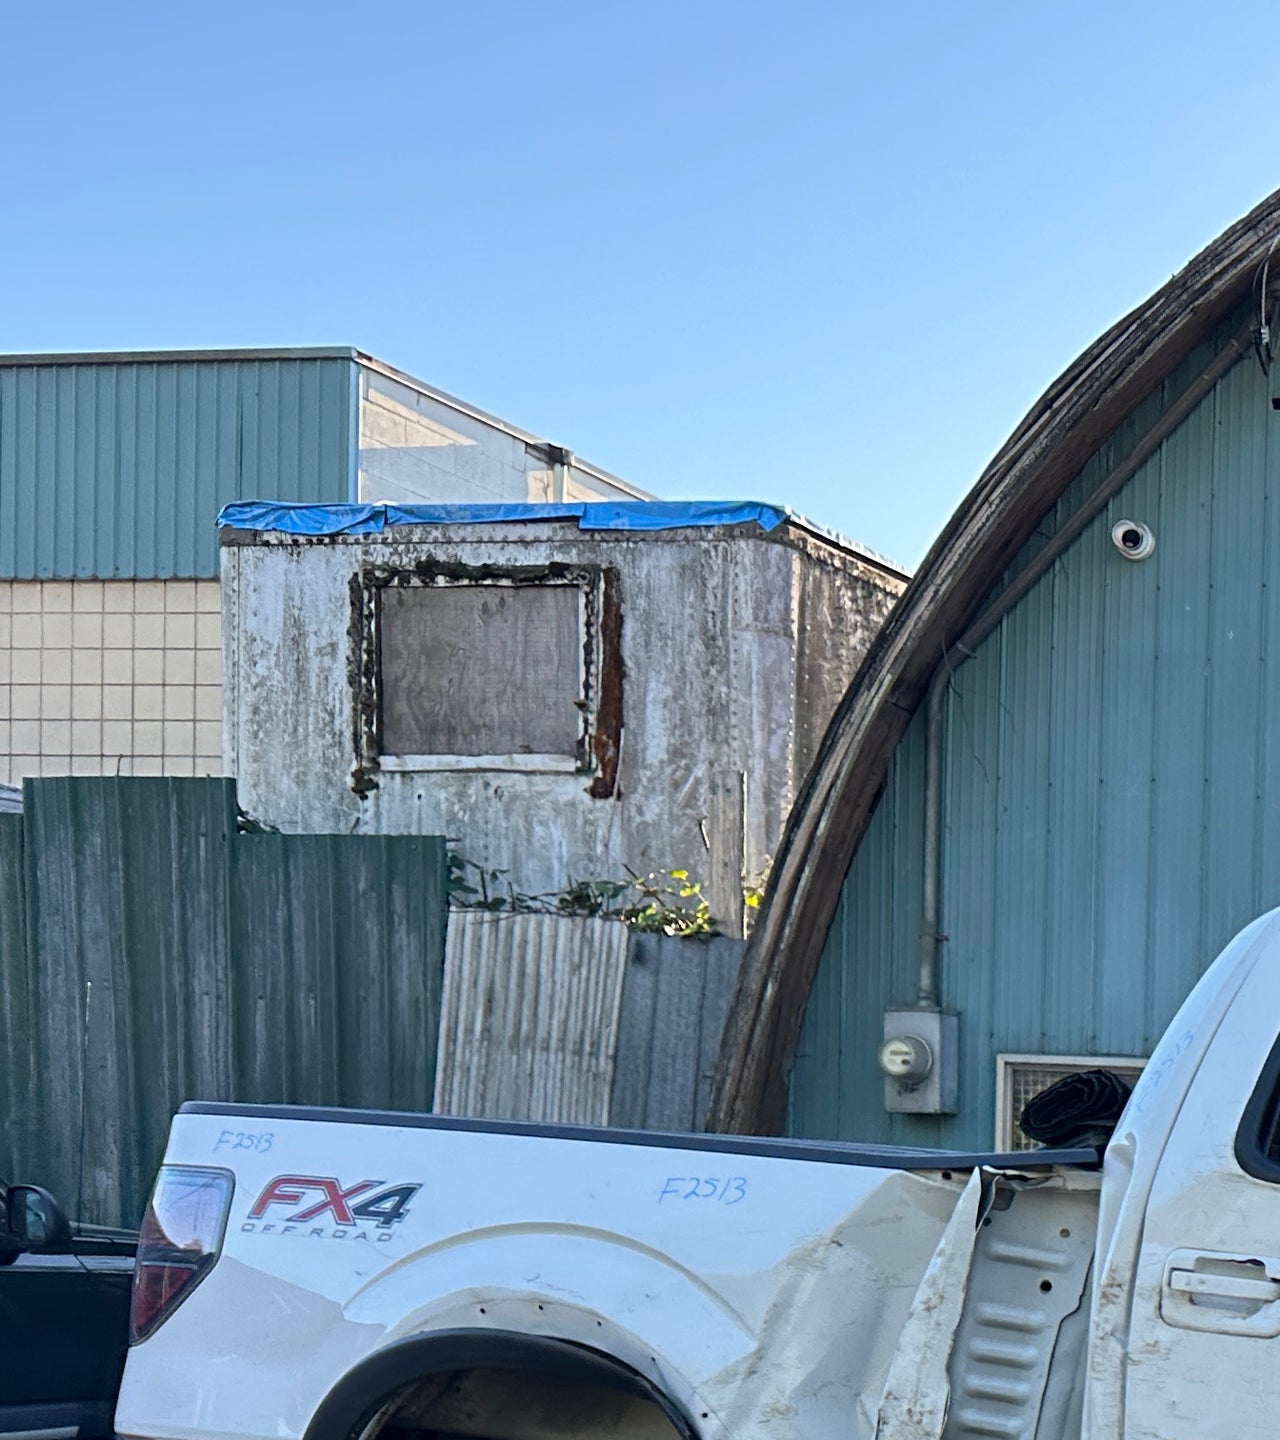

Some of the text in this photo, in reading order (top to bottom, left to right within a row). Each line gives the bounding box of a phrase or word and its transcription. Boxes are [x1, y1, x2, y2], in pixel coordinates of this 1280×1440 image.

[247, 1173, 424, 1230] FX4
[658, 1176, 748, 1206] F2513
[309, 1227, 393, 1243] ROAD
